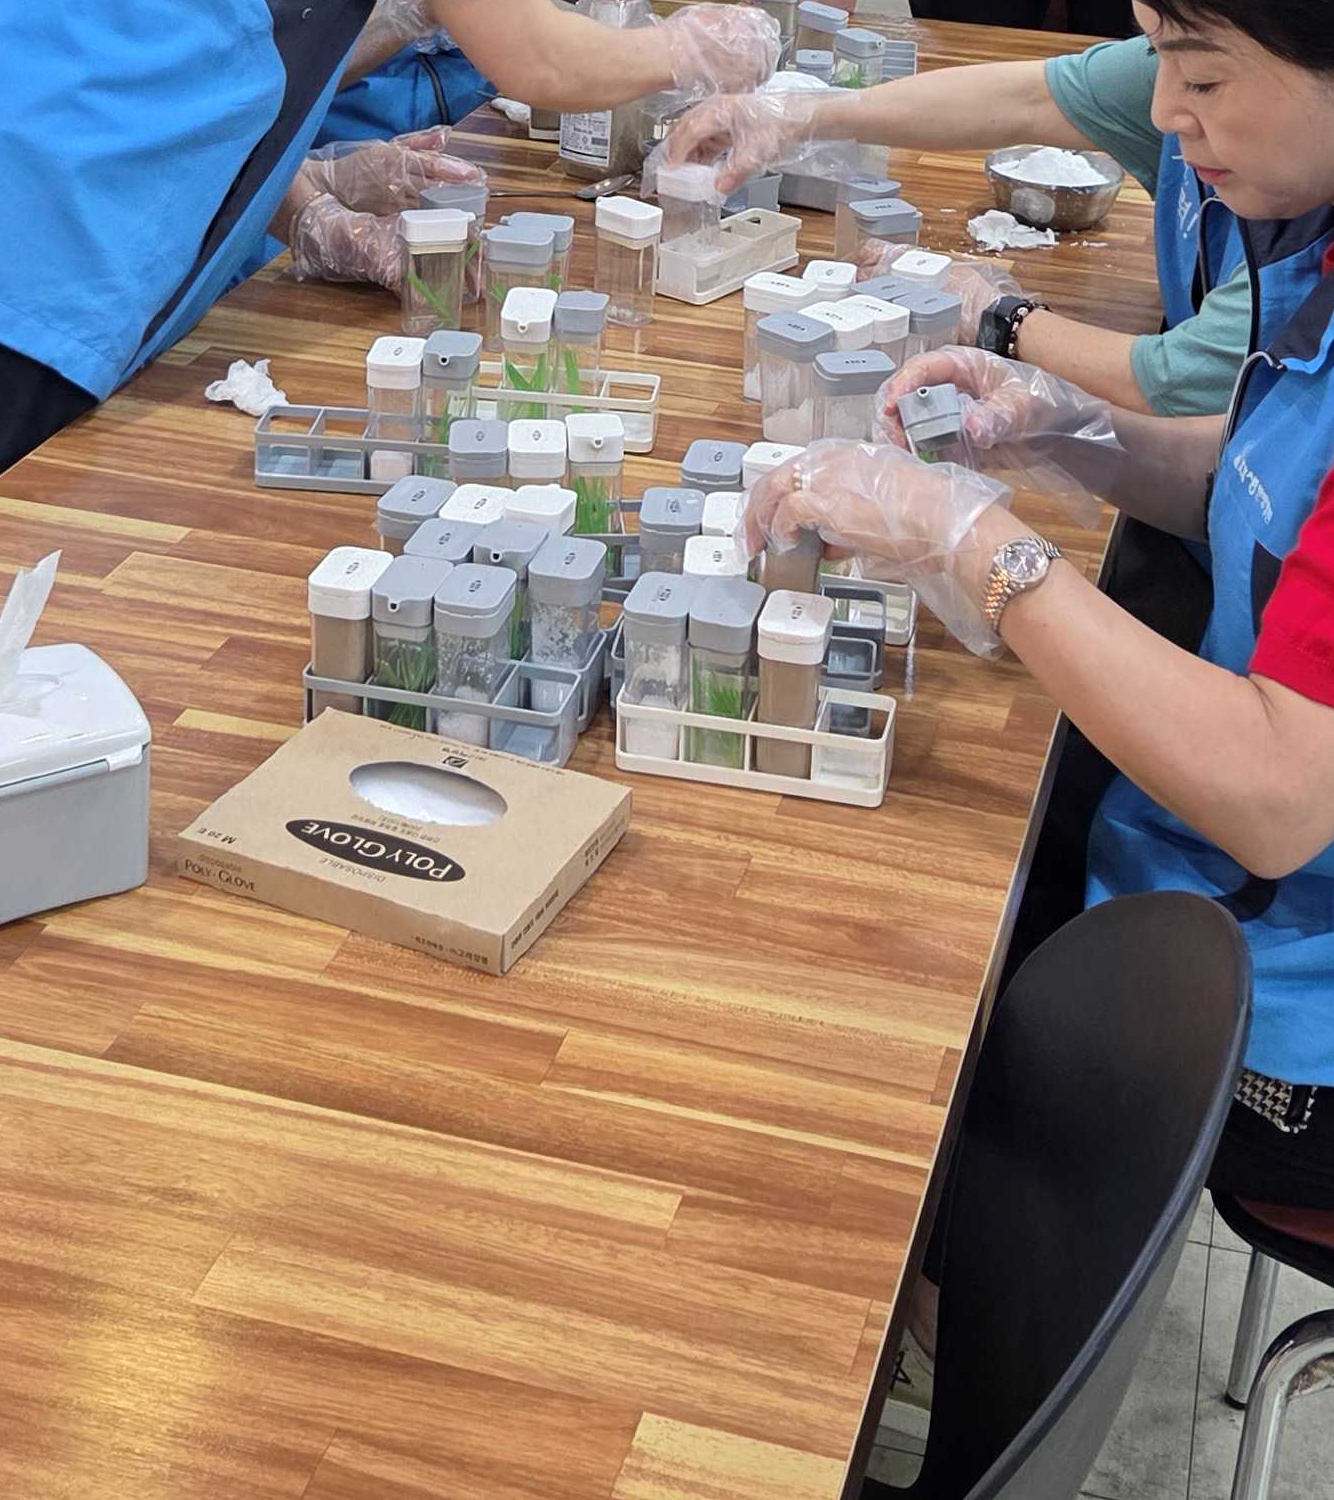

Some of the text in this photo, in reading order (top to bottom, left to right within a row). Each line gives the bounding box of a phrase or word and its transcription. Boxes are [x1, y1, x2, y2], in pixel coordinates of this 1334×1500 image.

[300, 821, 387, 858] GLOVE
[318, 857, 388, 883] DISPOSABLE
[385, 848, 454, 880] POLY
